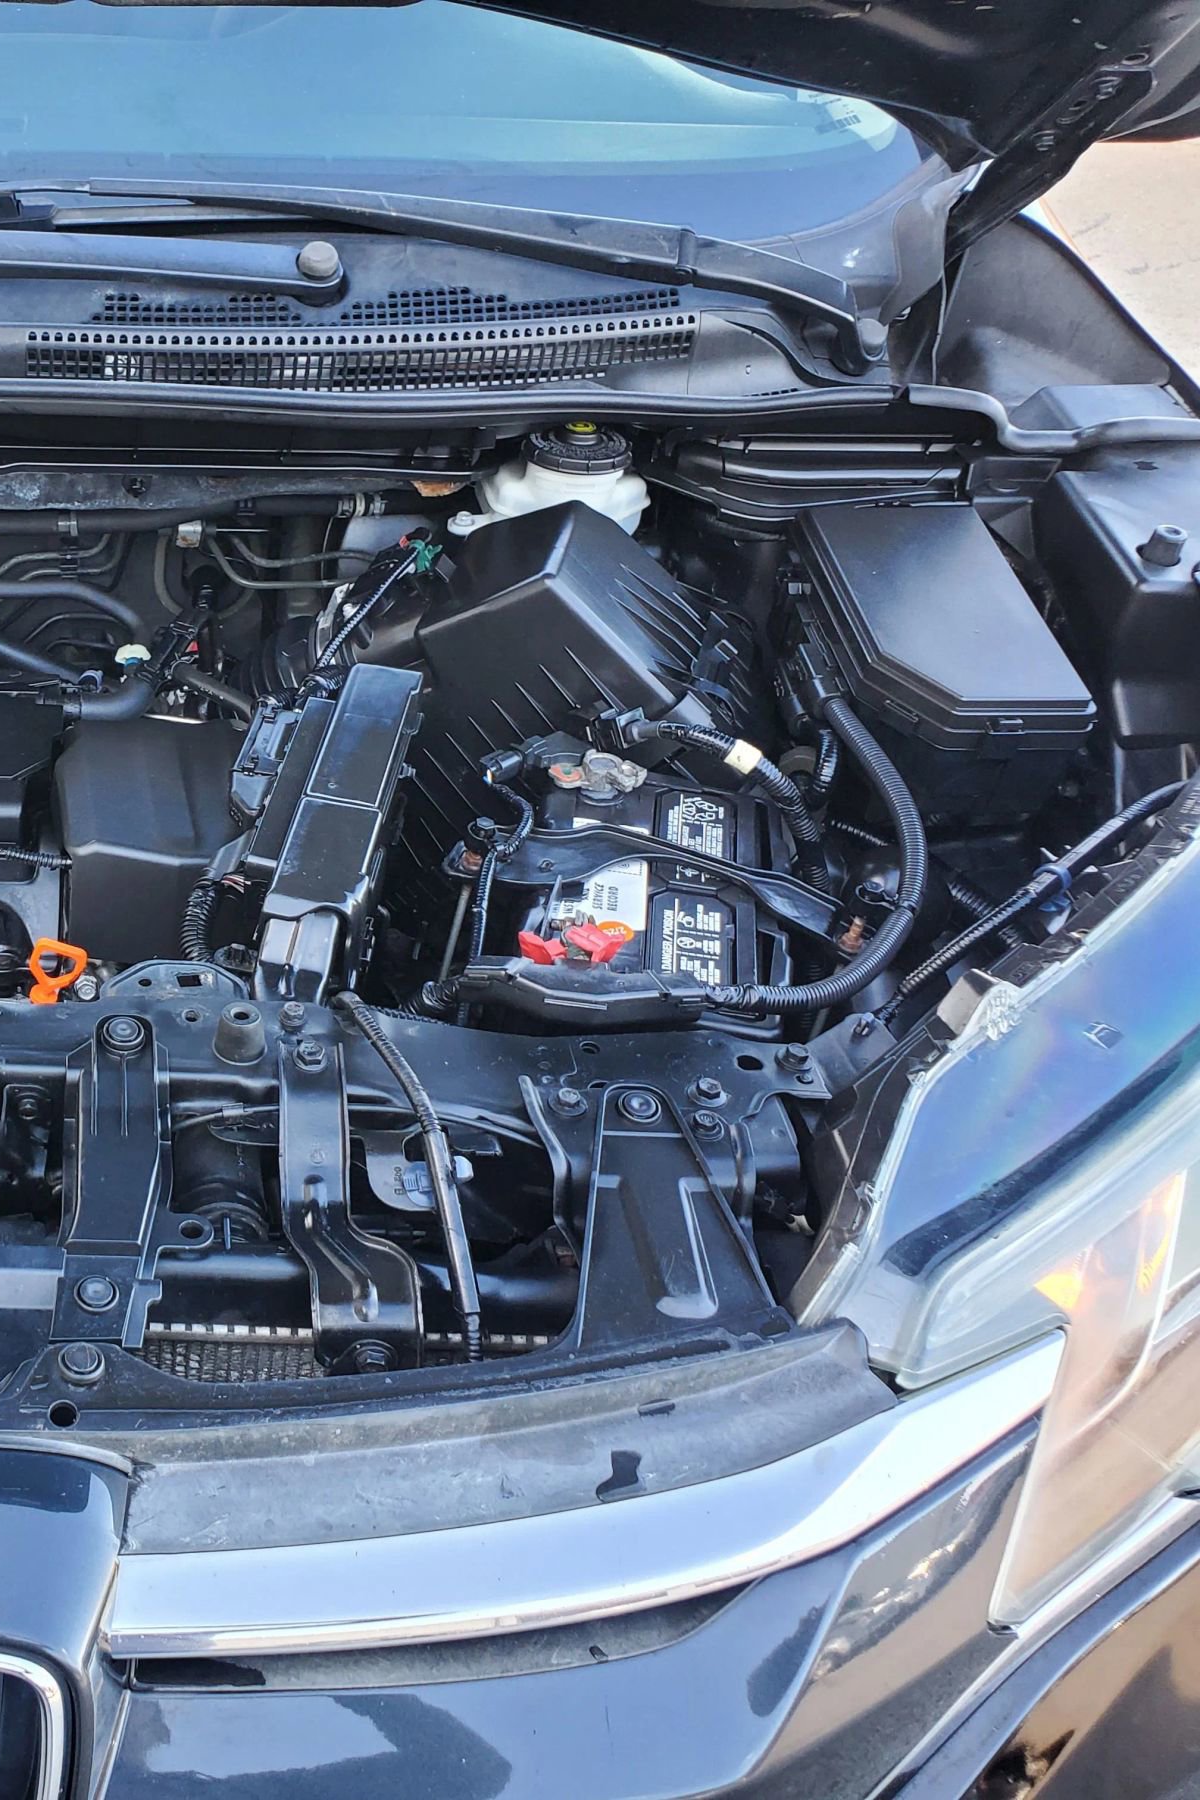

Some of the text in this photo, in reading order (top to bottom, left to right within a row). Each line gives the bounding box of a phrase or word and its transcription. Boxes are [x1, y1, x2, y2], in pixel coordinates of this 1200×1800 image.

[592, 881, 605, 910] SERVICE
[607, 885, 619, 912] RECORD
[663, 908, 675, 935] POISON
[661, 941, 673, 971] DANGER
